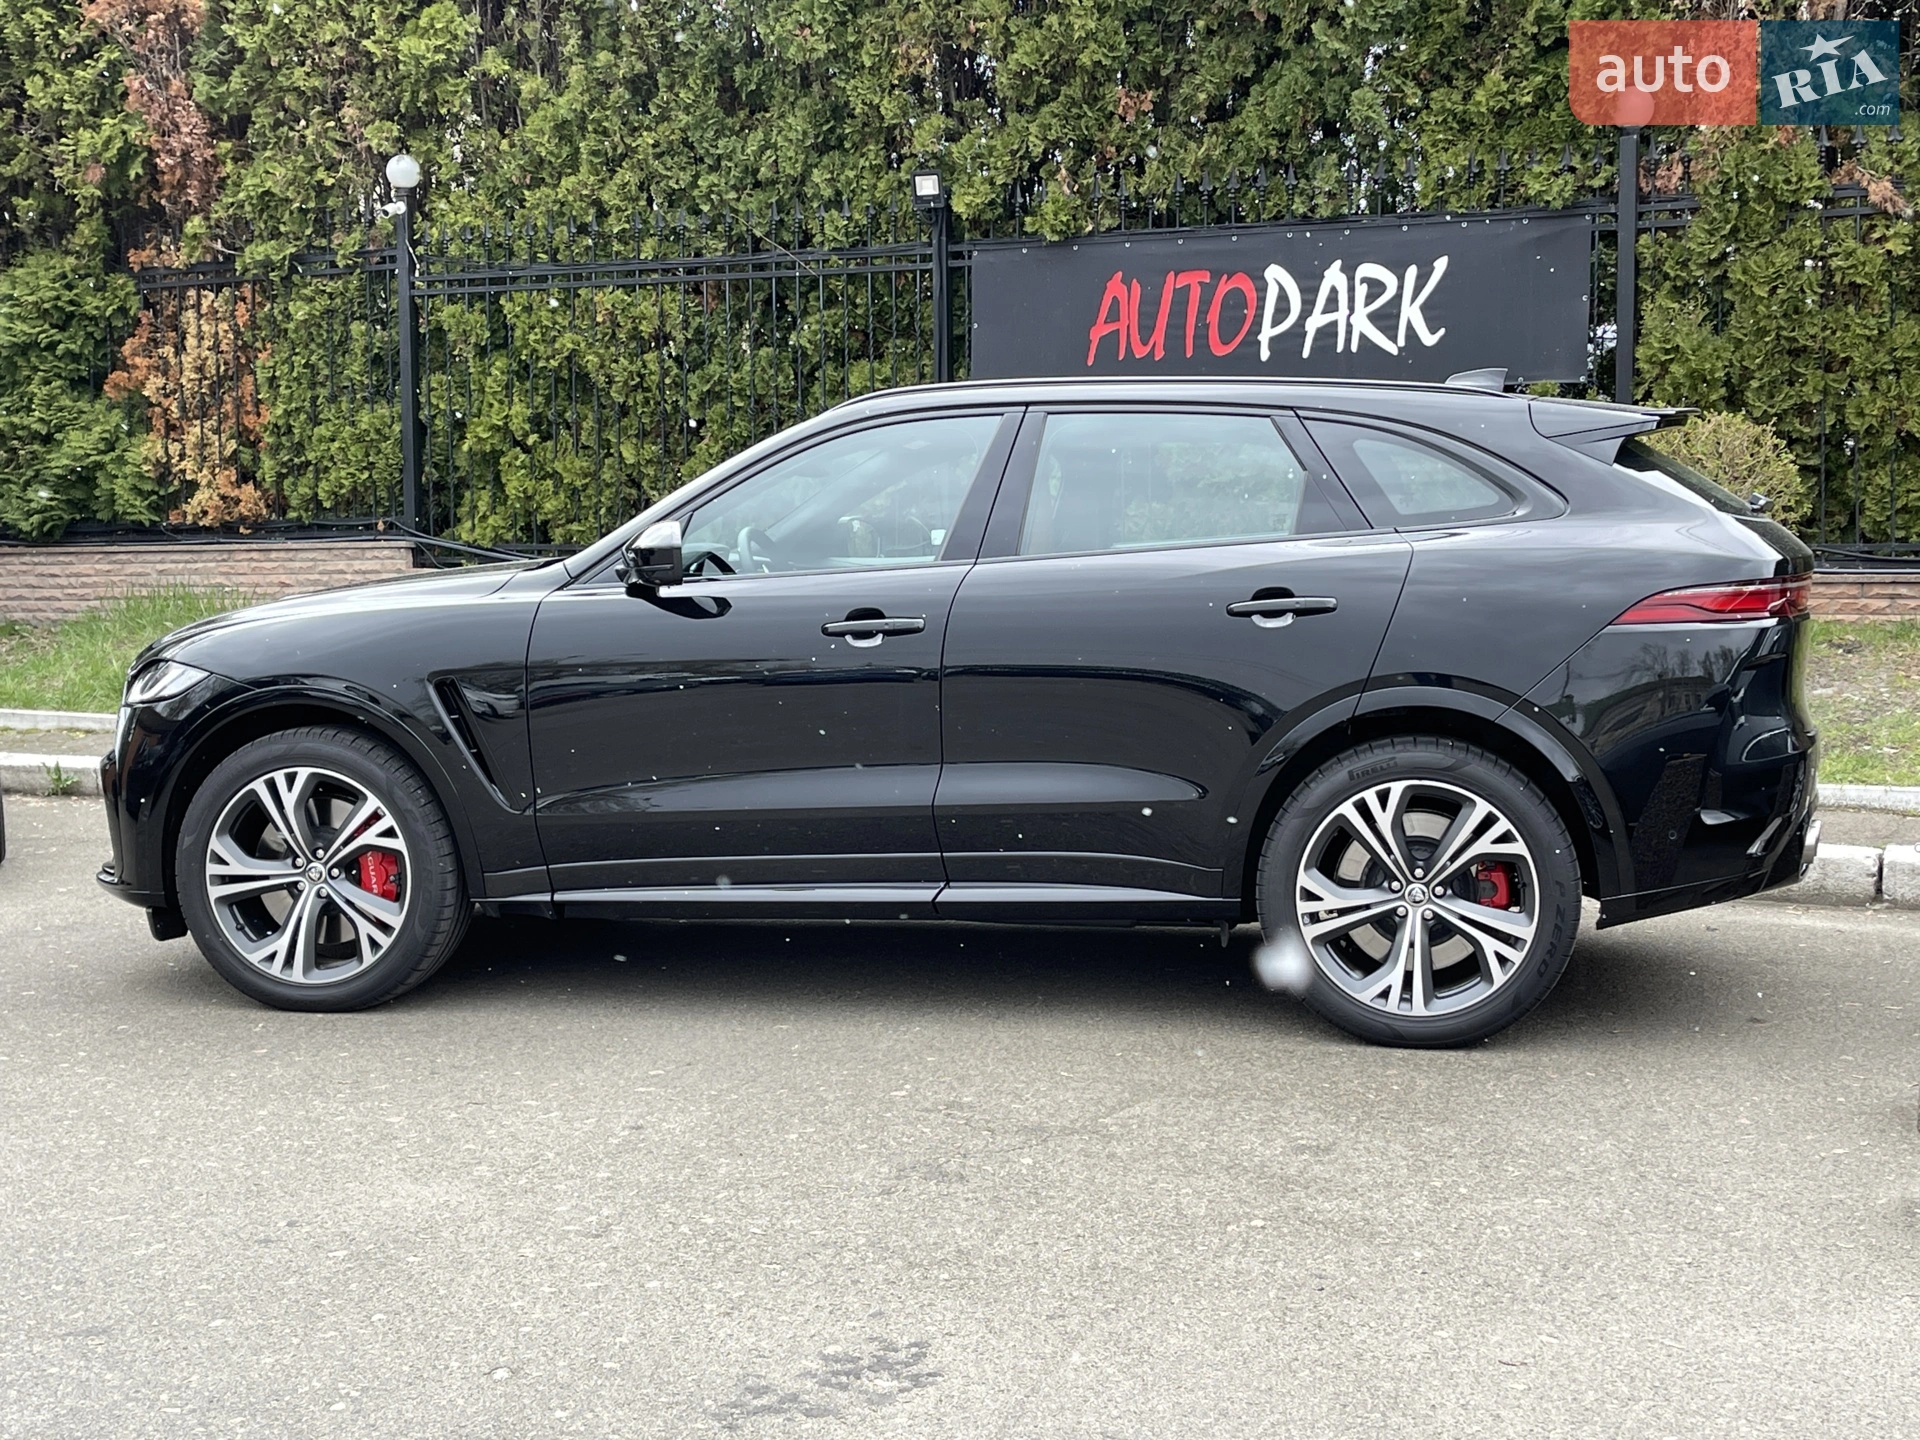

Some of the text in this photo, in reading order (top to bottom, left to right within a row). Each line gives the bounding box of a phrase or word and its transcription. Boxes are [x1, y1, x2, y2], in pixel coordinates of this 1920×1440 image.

[1086, 254, 1449, 366] AUTOPARK
[1347, 756, 1398, 781] PIRELLI
[1536, 903, 1566, 978] ZERO
